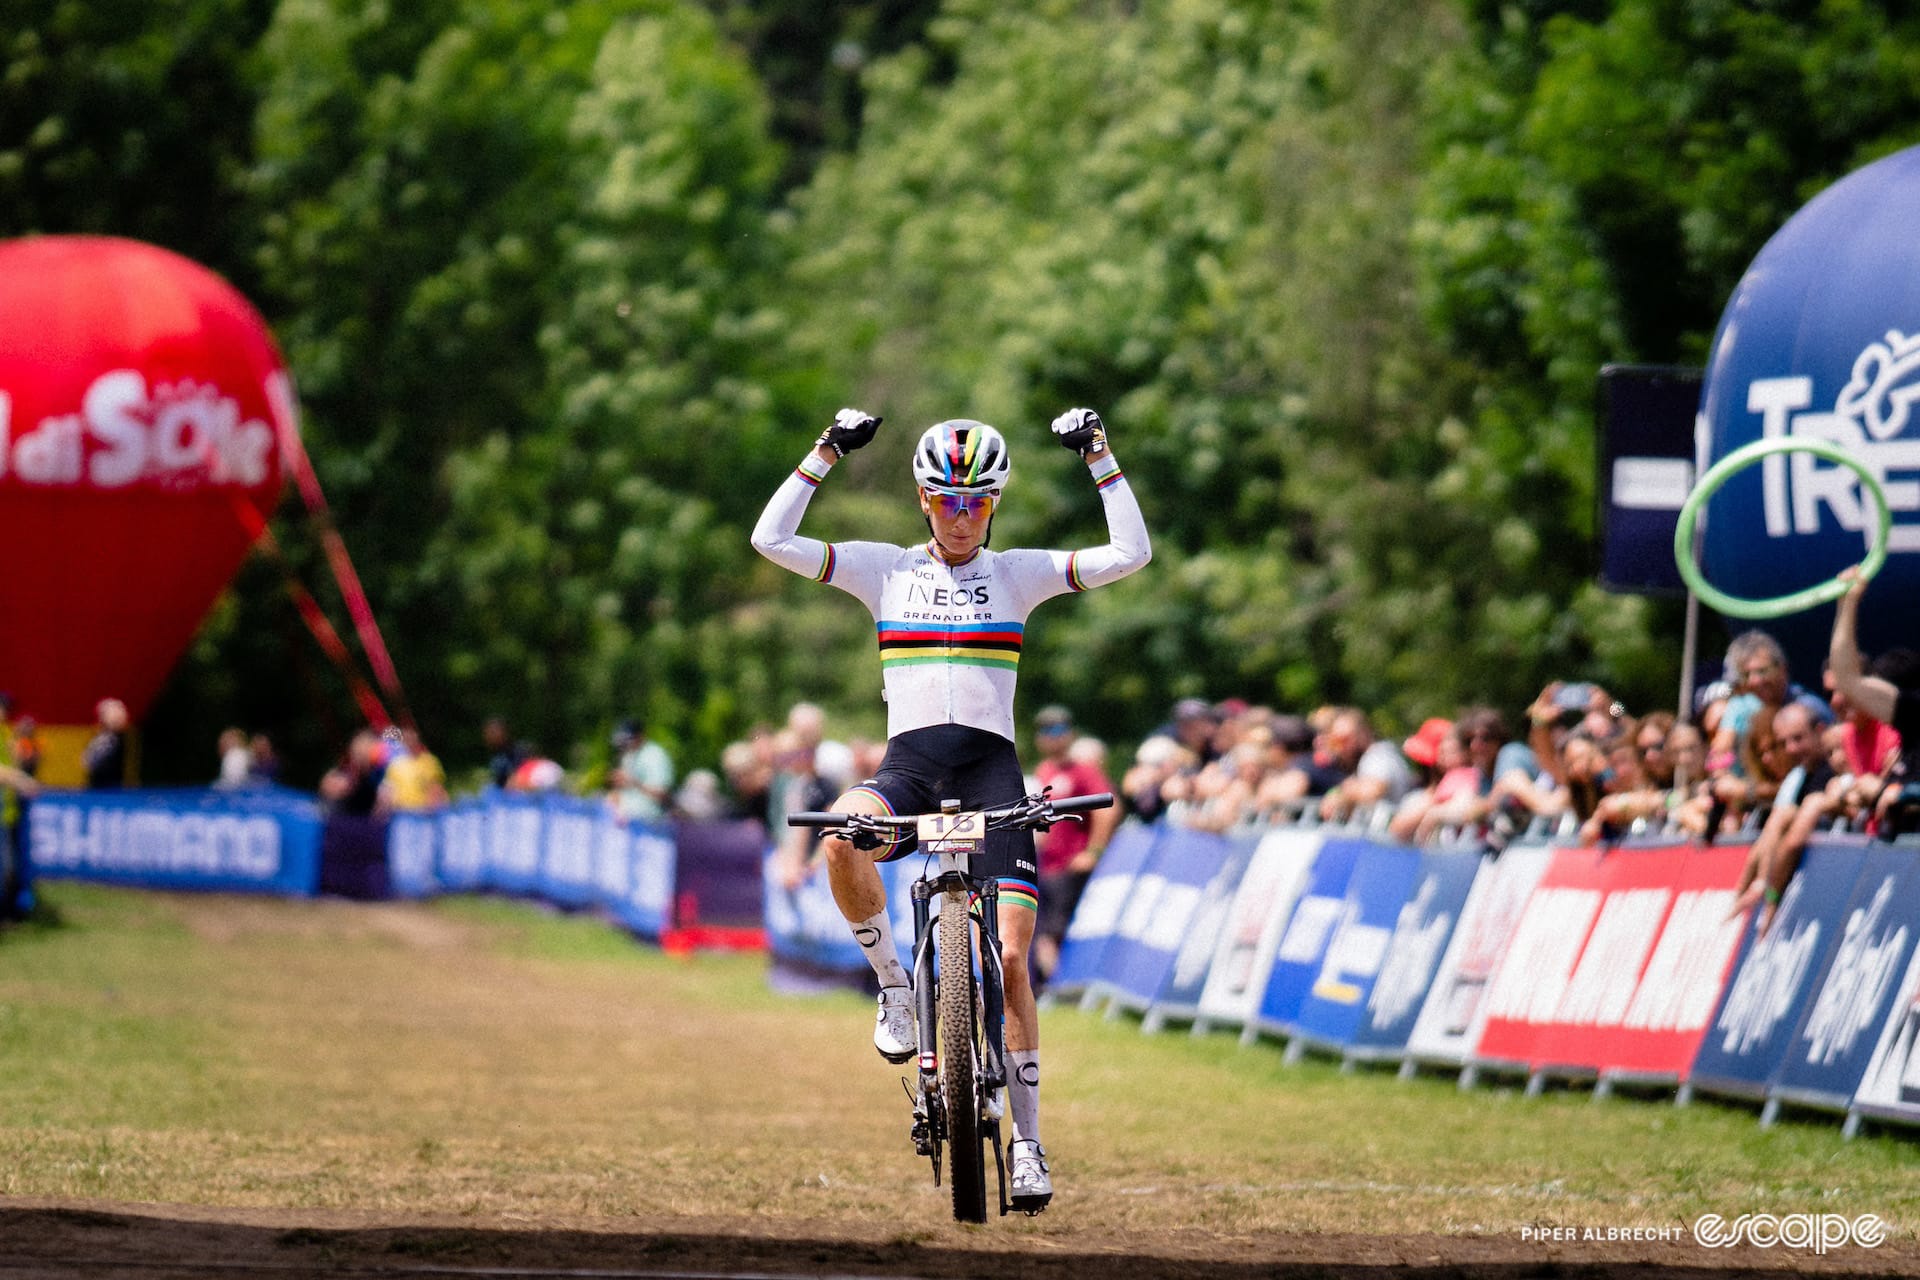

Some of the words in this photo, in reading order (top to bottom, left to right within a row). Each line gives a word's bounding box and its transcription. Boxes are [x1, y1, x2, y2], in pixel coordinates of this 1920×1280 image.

[915, 570, 934, 581] UCI
[908, 584, 989, 606] INEOS
[904, 612, 992, 622] GRENADIER
[29, 802, 281, 879] SHIMANO
